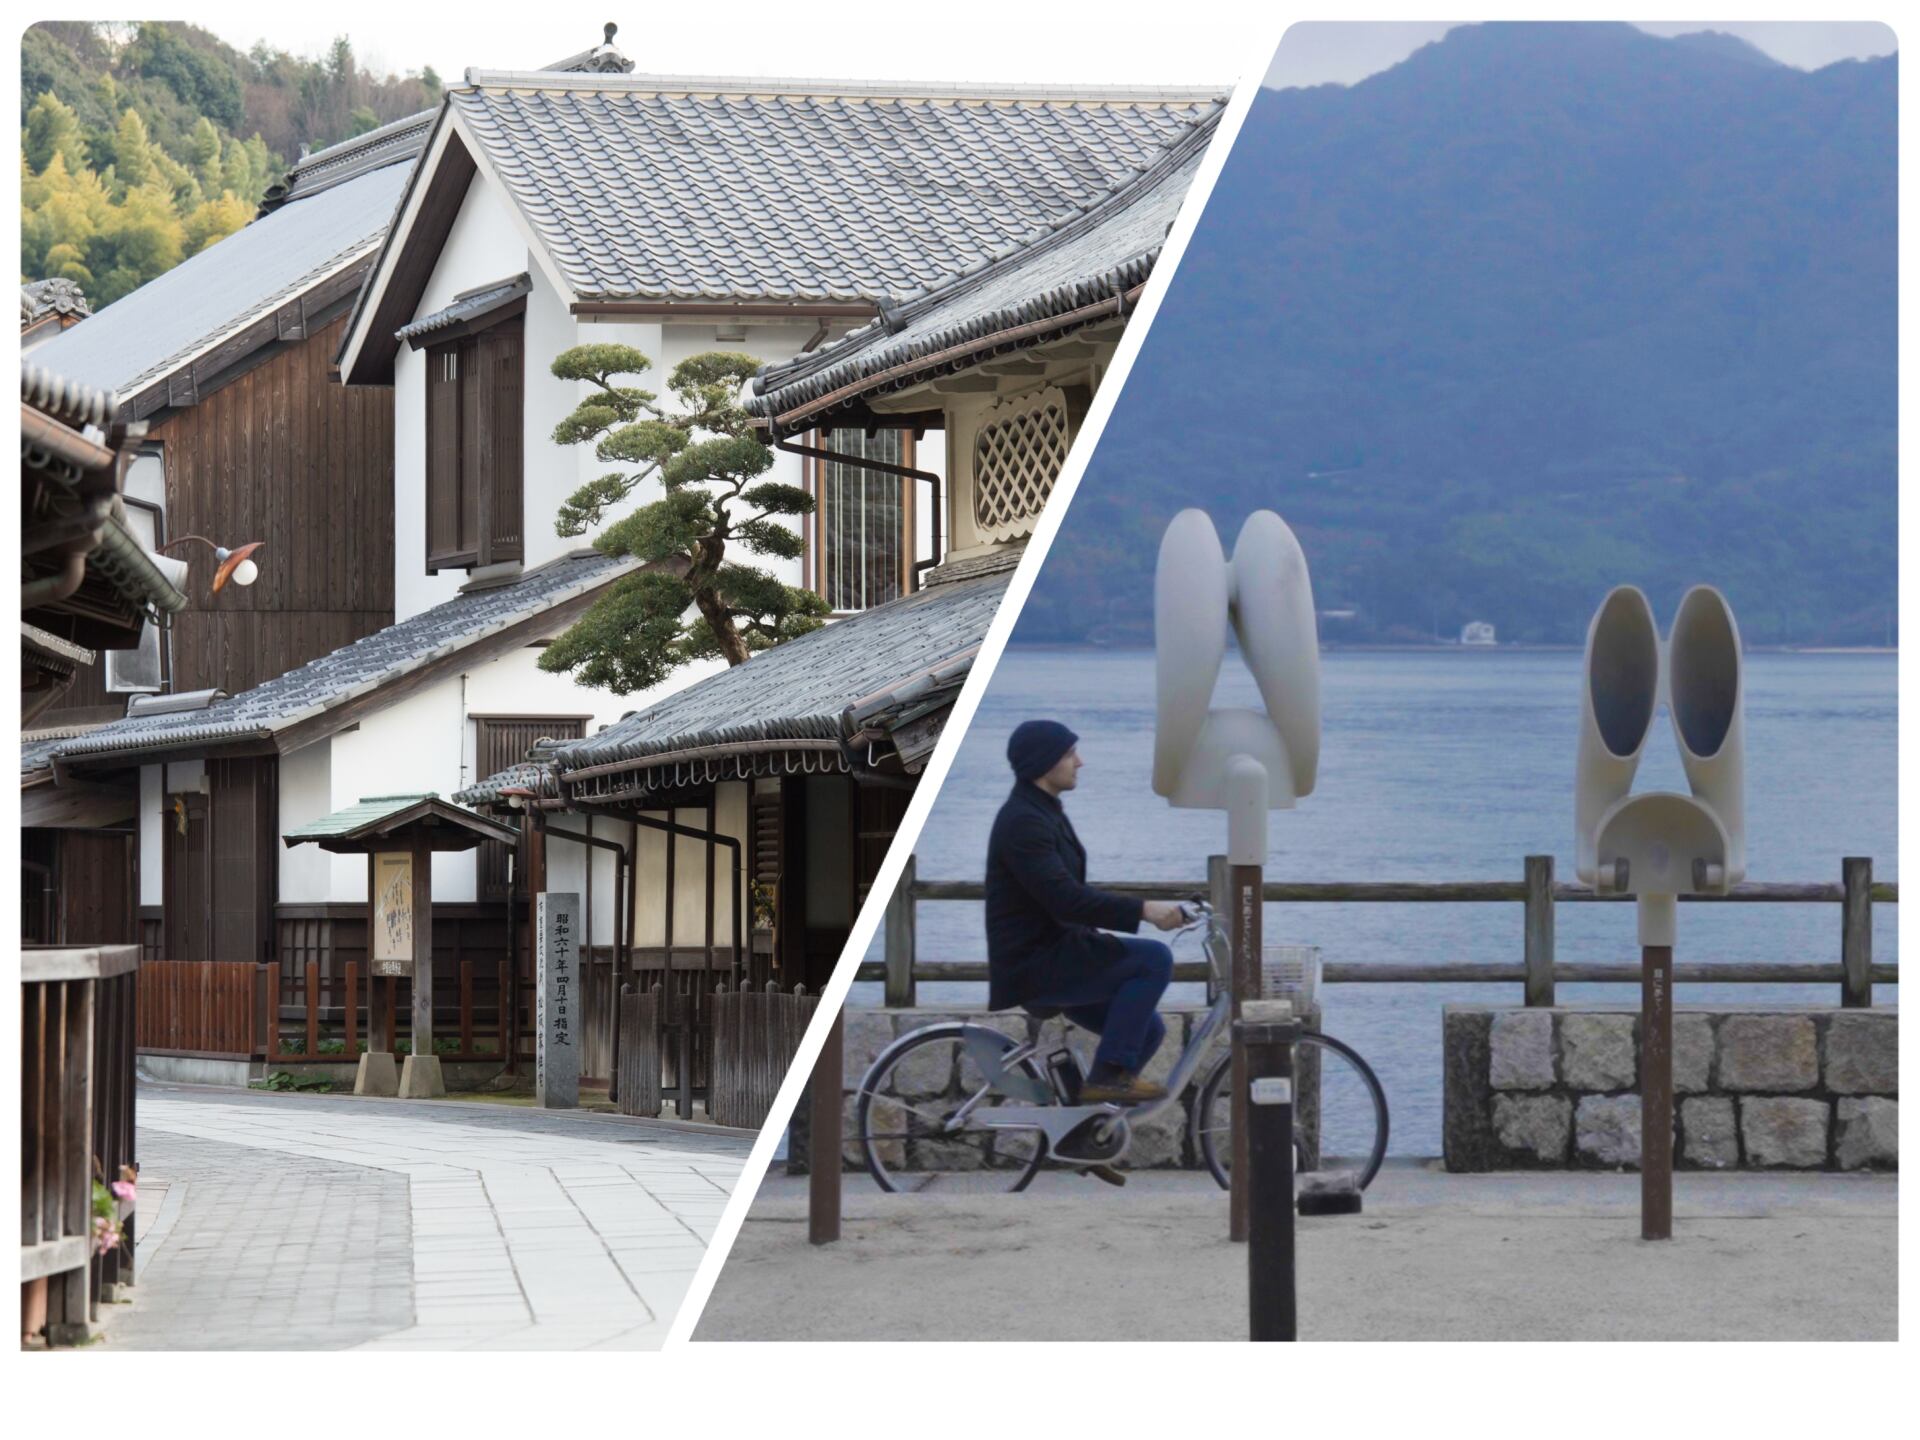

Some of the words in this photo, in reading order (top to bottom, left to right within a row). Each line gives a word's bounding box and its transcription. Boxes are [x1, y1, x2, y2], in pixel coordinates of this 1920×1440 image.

[553, 913, 571, 1046] 昭和六十年四月十日指定
